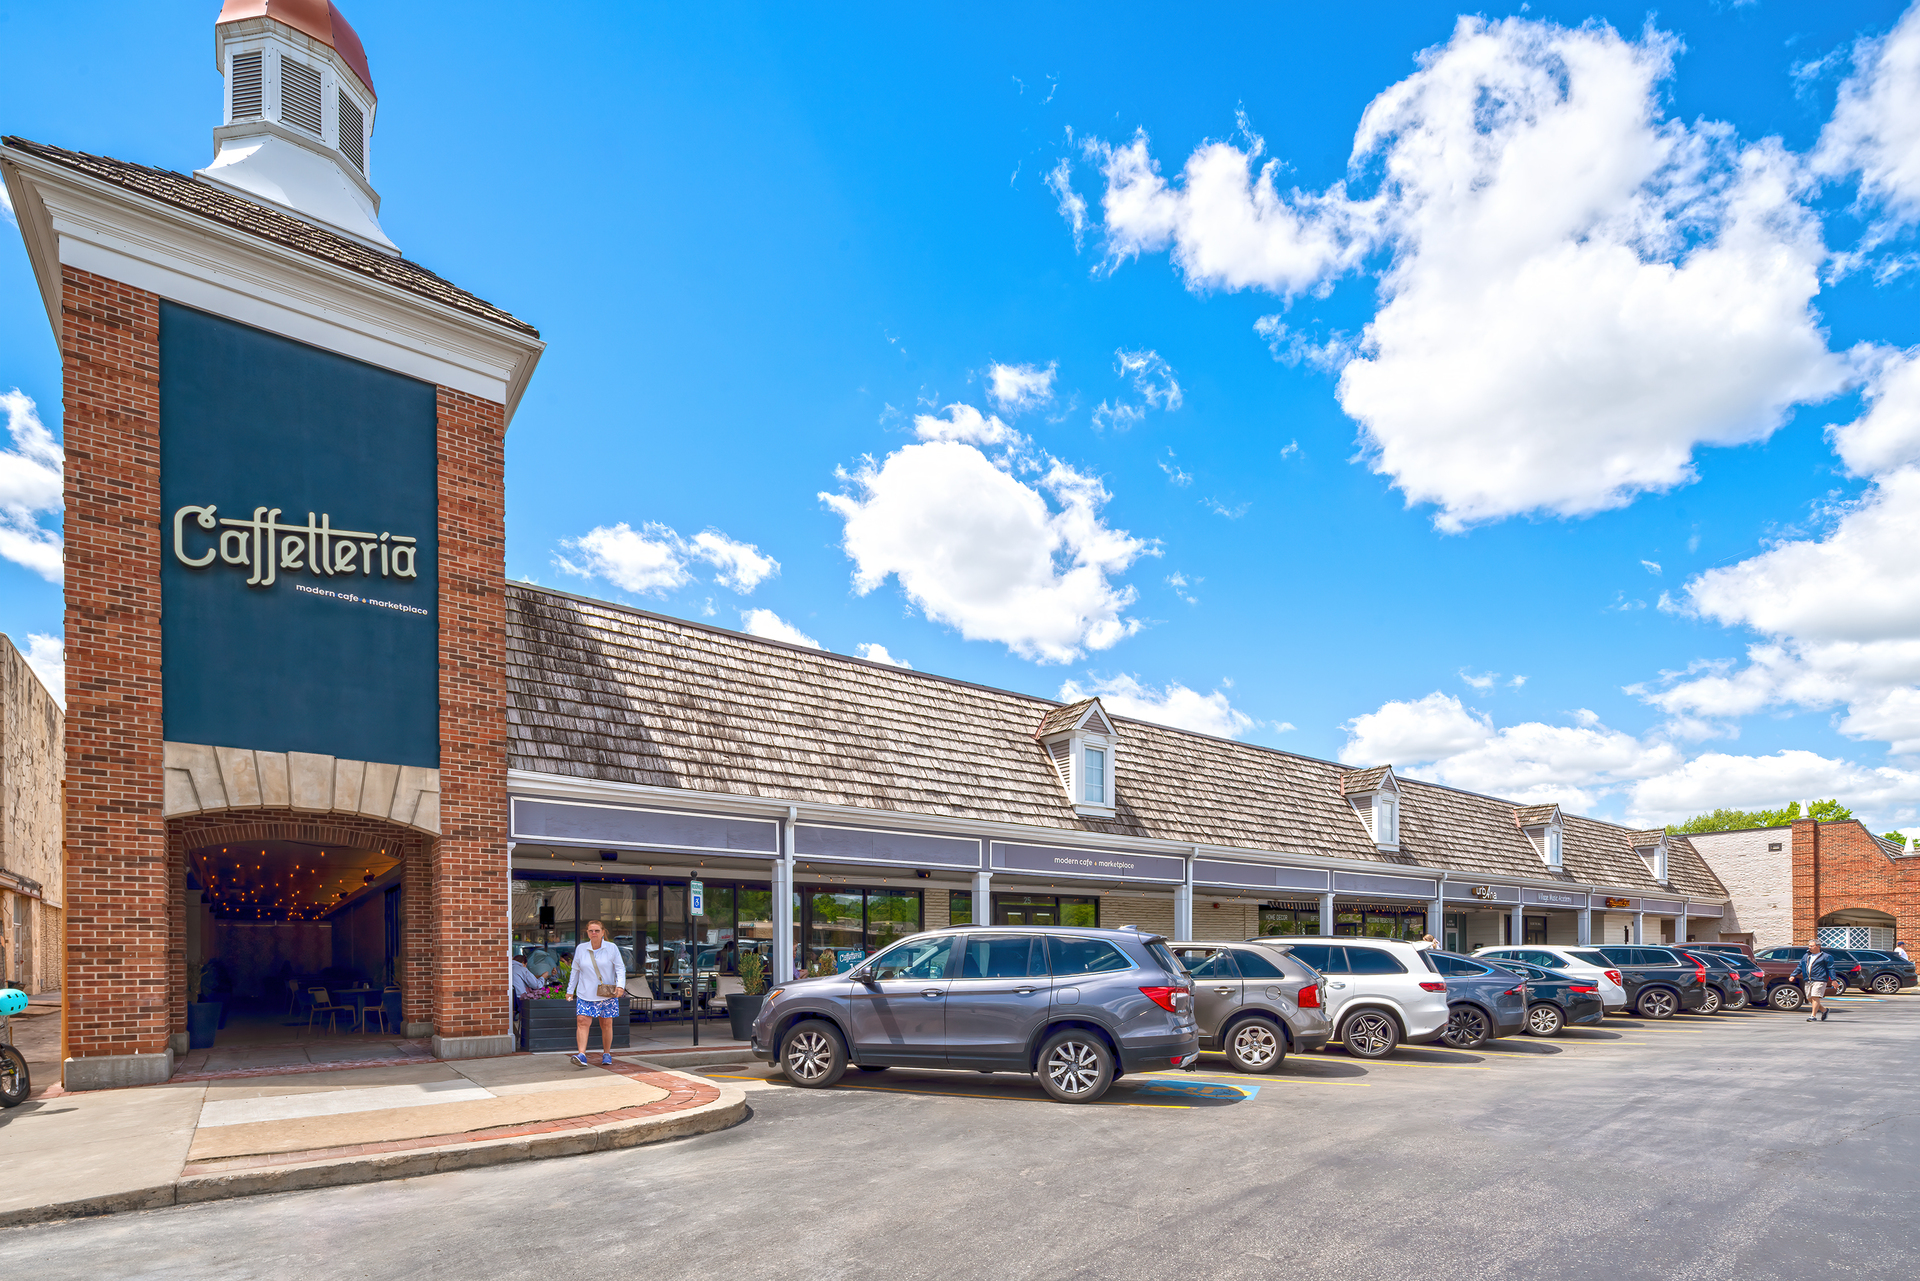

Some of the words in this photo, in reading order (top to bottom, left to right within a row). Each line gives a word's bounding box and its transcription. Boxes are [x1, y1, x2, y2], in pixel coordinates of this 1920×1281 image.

[295, 584, 336, 598] modern
[337, 592, 359, 602] cafe
[369, 598, 428, 615] marketplace
[1054, 857, 1079, 865] modern
[1079, 858, 1093, 867] cafe
[1098, 860, 1135, 869] marketplace
[1023, 896, 1032, 904] 25
[1538, 892, 1549, 902] Village
[1549, 893, 1559, 902] Music
[1559, 894, 1572, 904] Academy
